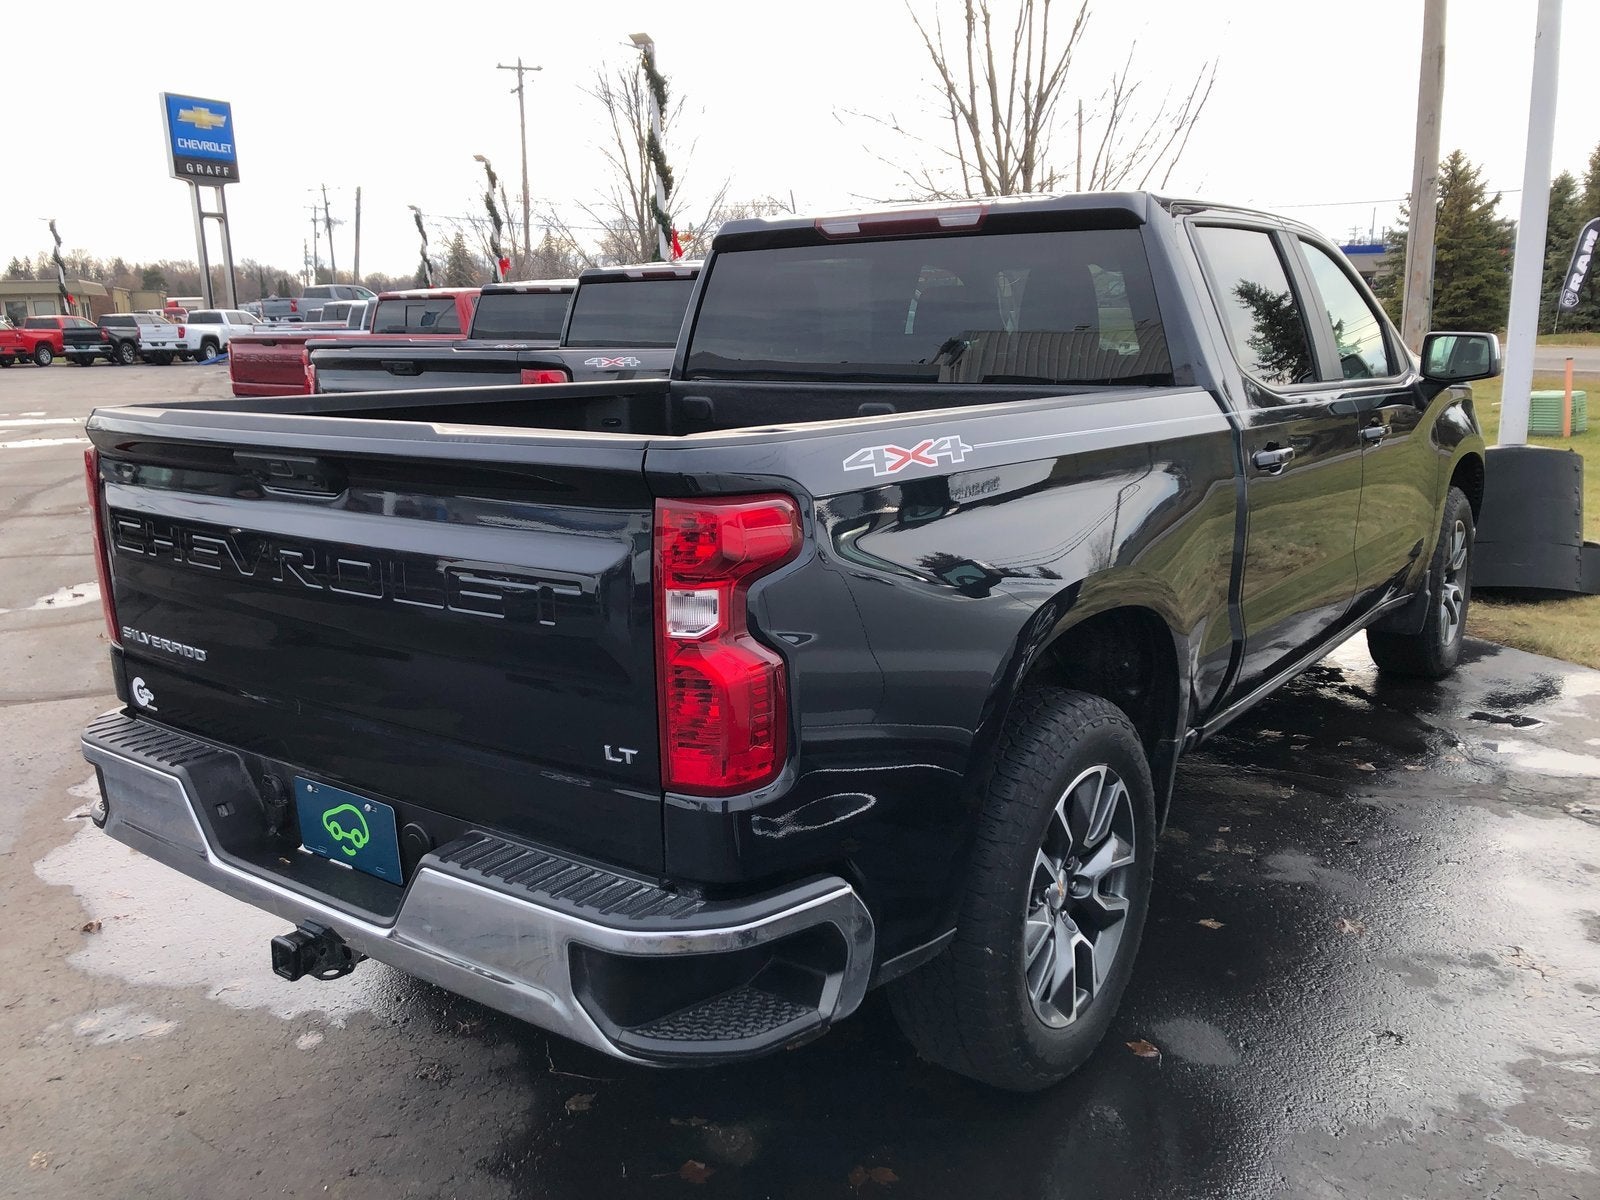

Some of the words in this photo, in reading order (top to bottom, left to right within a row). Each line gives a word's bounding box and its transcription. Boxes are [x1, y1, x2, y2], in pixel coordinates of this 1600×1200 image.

[177, 137, 232, 153] CHEVROLET
[186, 162, 229, 176] GRAFF
[1568, 228, 1599, 292] RAM
[111, 513, 583, 627] CHEVROLET
[122, 625, 207, 662] SILVERADO
[604, 744, 639, 765] LT
